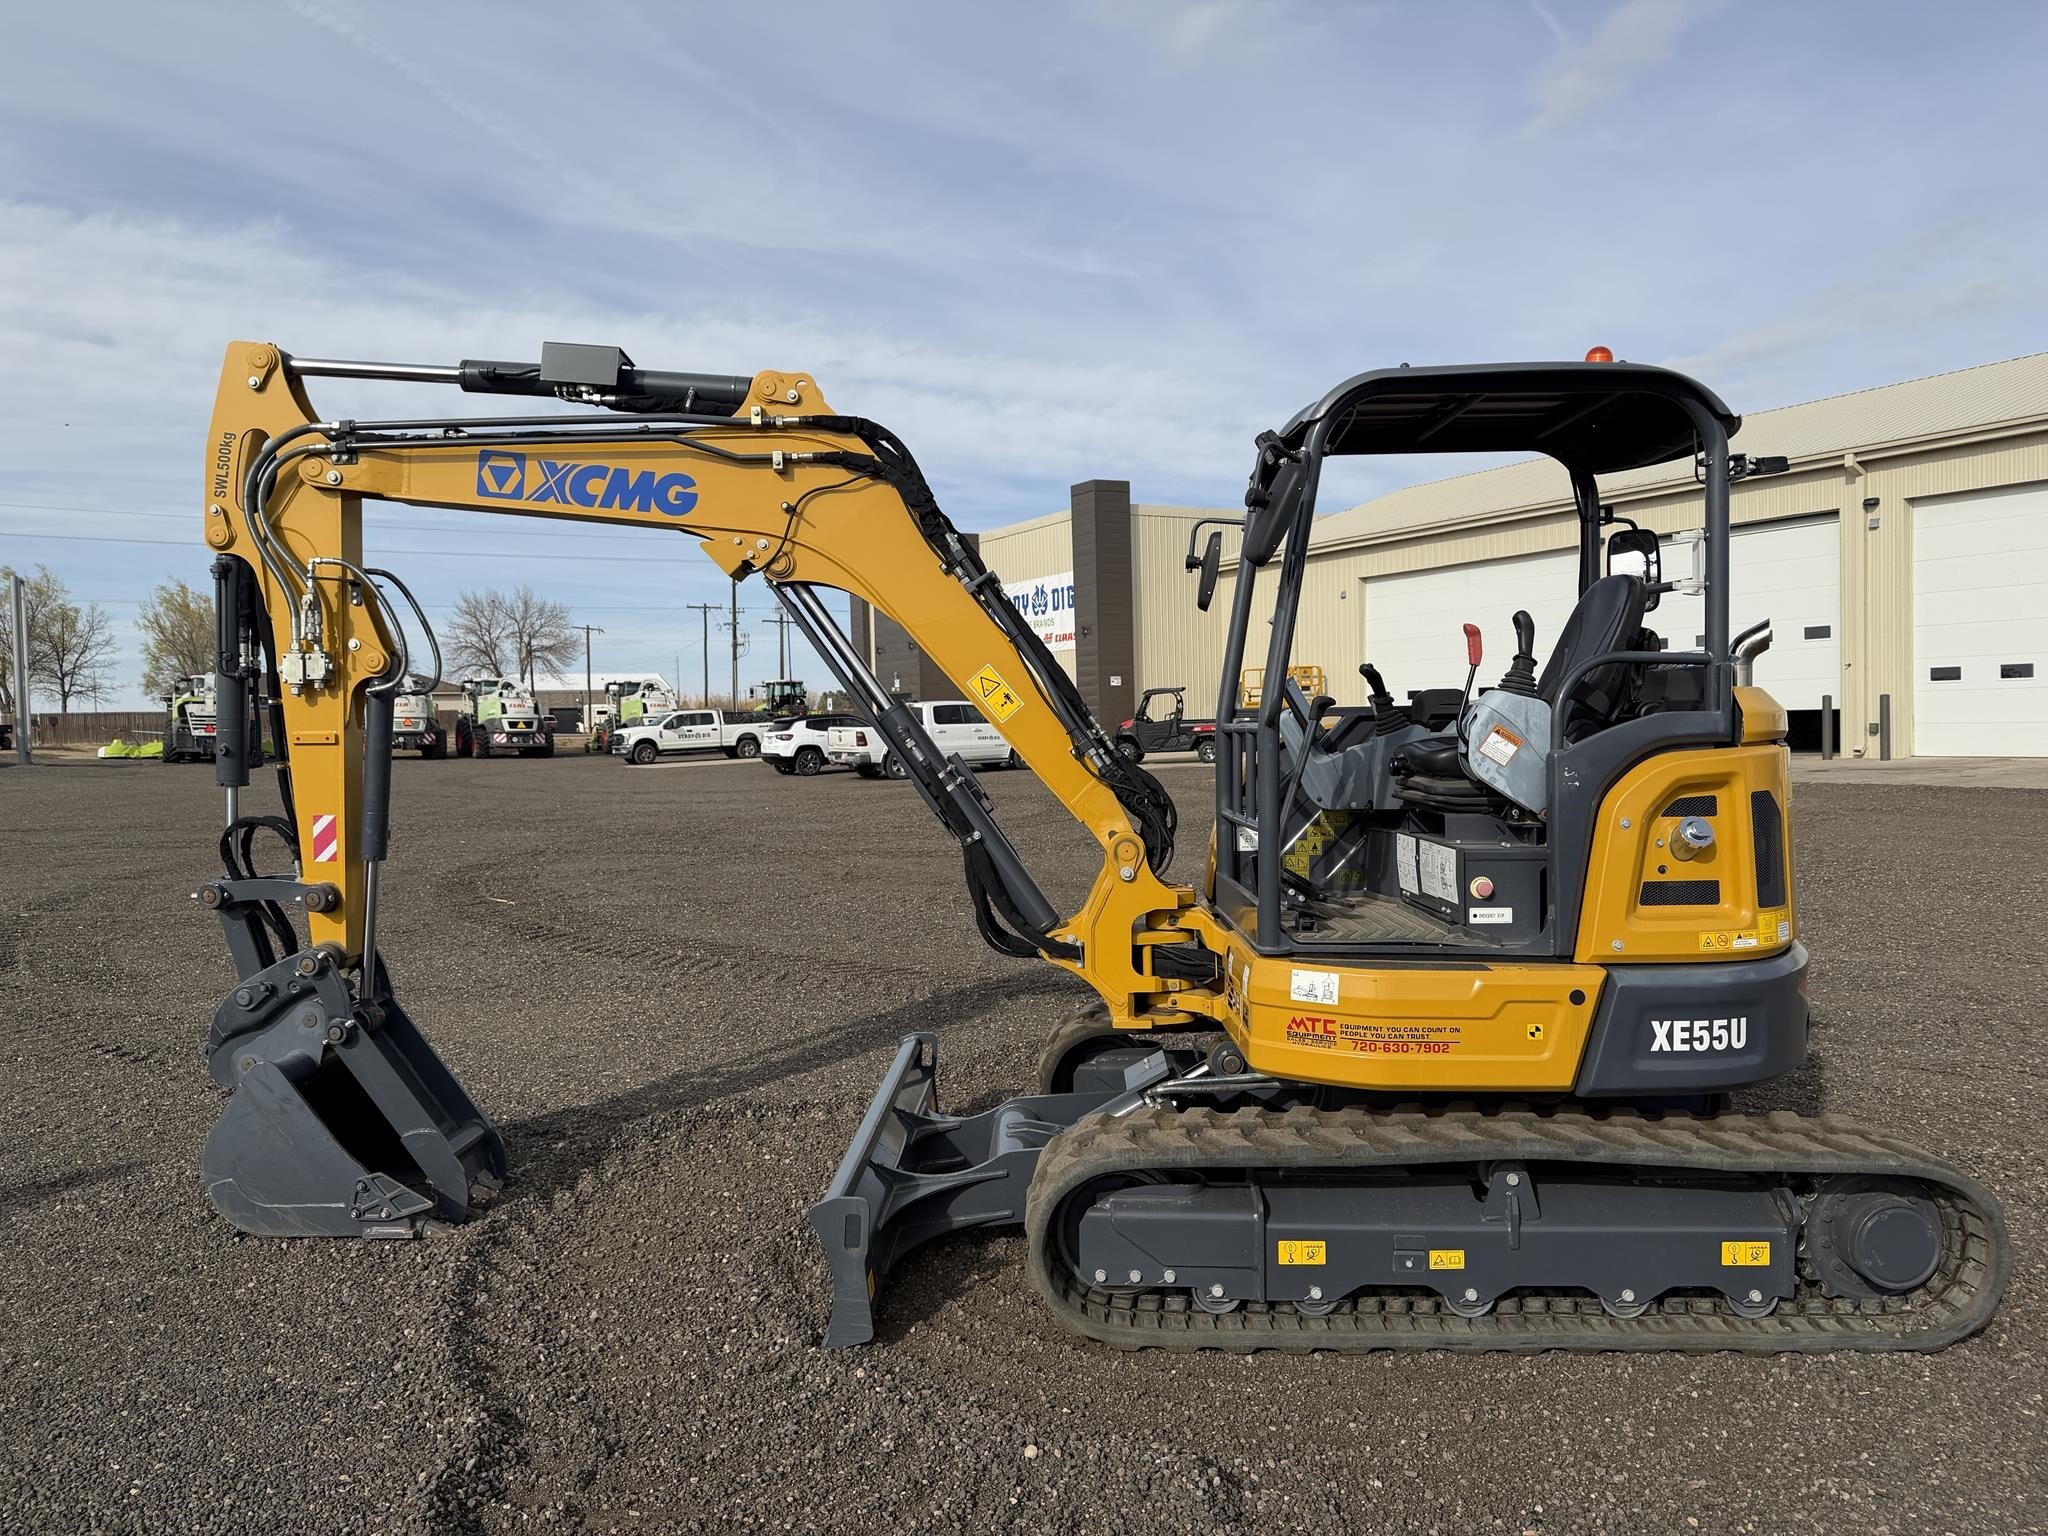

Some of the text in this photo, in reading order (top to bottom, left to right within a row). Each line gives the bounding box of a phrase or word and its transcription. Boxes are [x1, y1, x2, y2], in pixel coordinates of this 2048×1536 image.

[213, 431, 237, 499] SWL500kg
[524, 460, 699, 517] XCMG
[1286, 1016, 1337, 1035] MTC
[1340, 1023, 1383, 1033] EQUIPMENT
[1386, 1025, 1400, 1033] YOU
[1286, 1031, 1337, 1041] EQUIPMENT
[1340, 1030, 1367, 1038] PEOPLE
[1370, 1031, 1386, 1039] YOU
[1388, 1032, 1404, 1040] CAN
[1650, 1017, 1747, 1052] XE55U
[1351, 1041, 1450, 1054] 720-630-7902
